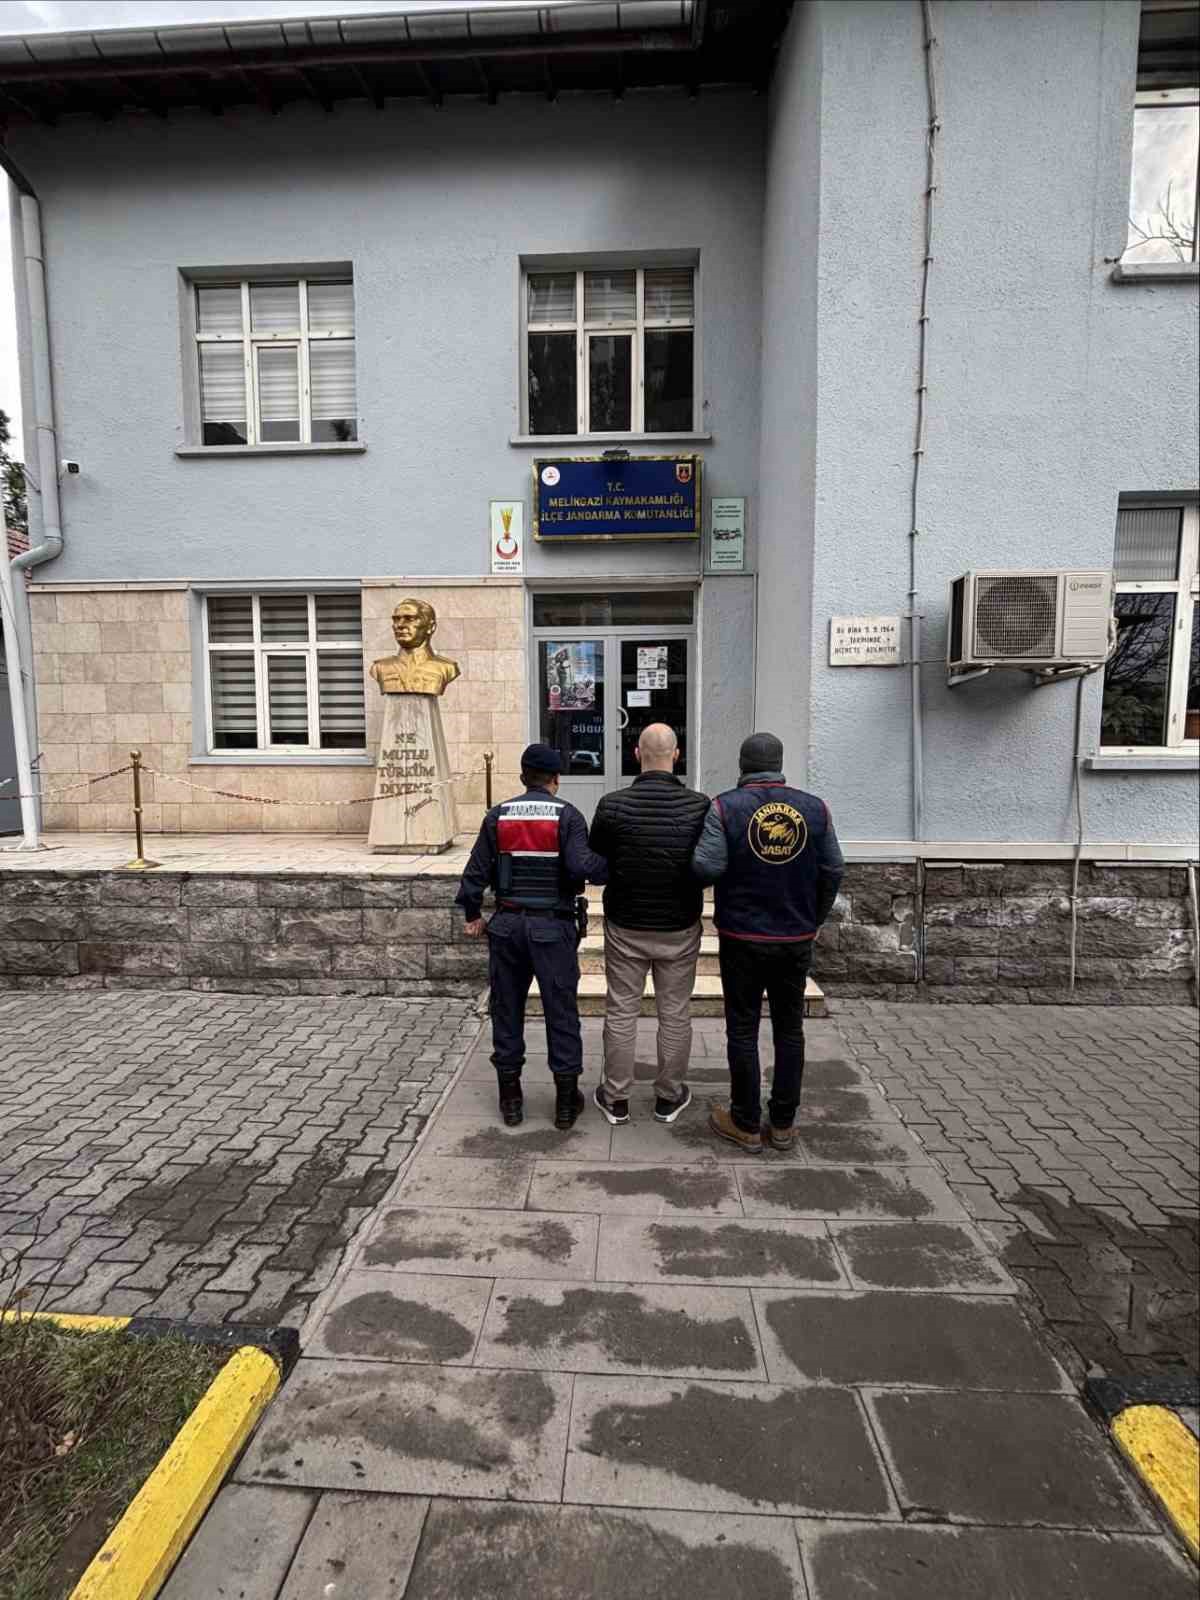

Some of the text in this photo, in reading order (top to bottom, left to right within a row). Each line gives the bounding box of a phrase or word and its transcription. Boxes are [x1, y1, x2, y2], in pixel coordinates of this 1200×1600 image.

[607, 482, 625, 492] T.C.
[548, 493, 684, 507] MELİKGAZİ KAYMAKAMLIĞI
[541, 507, 694, 523] İLÇE JANDARMA KOMUTANLIĞI
[395, 732, 417, 744] NE
[382, 749, 430, 760] MUTLU
[378, 762, 435, 777] TÜRKÜM
